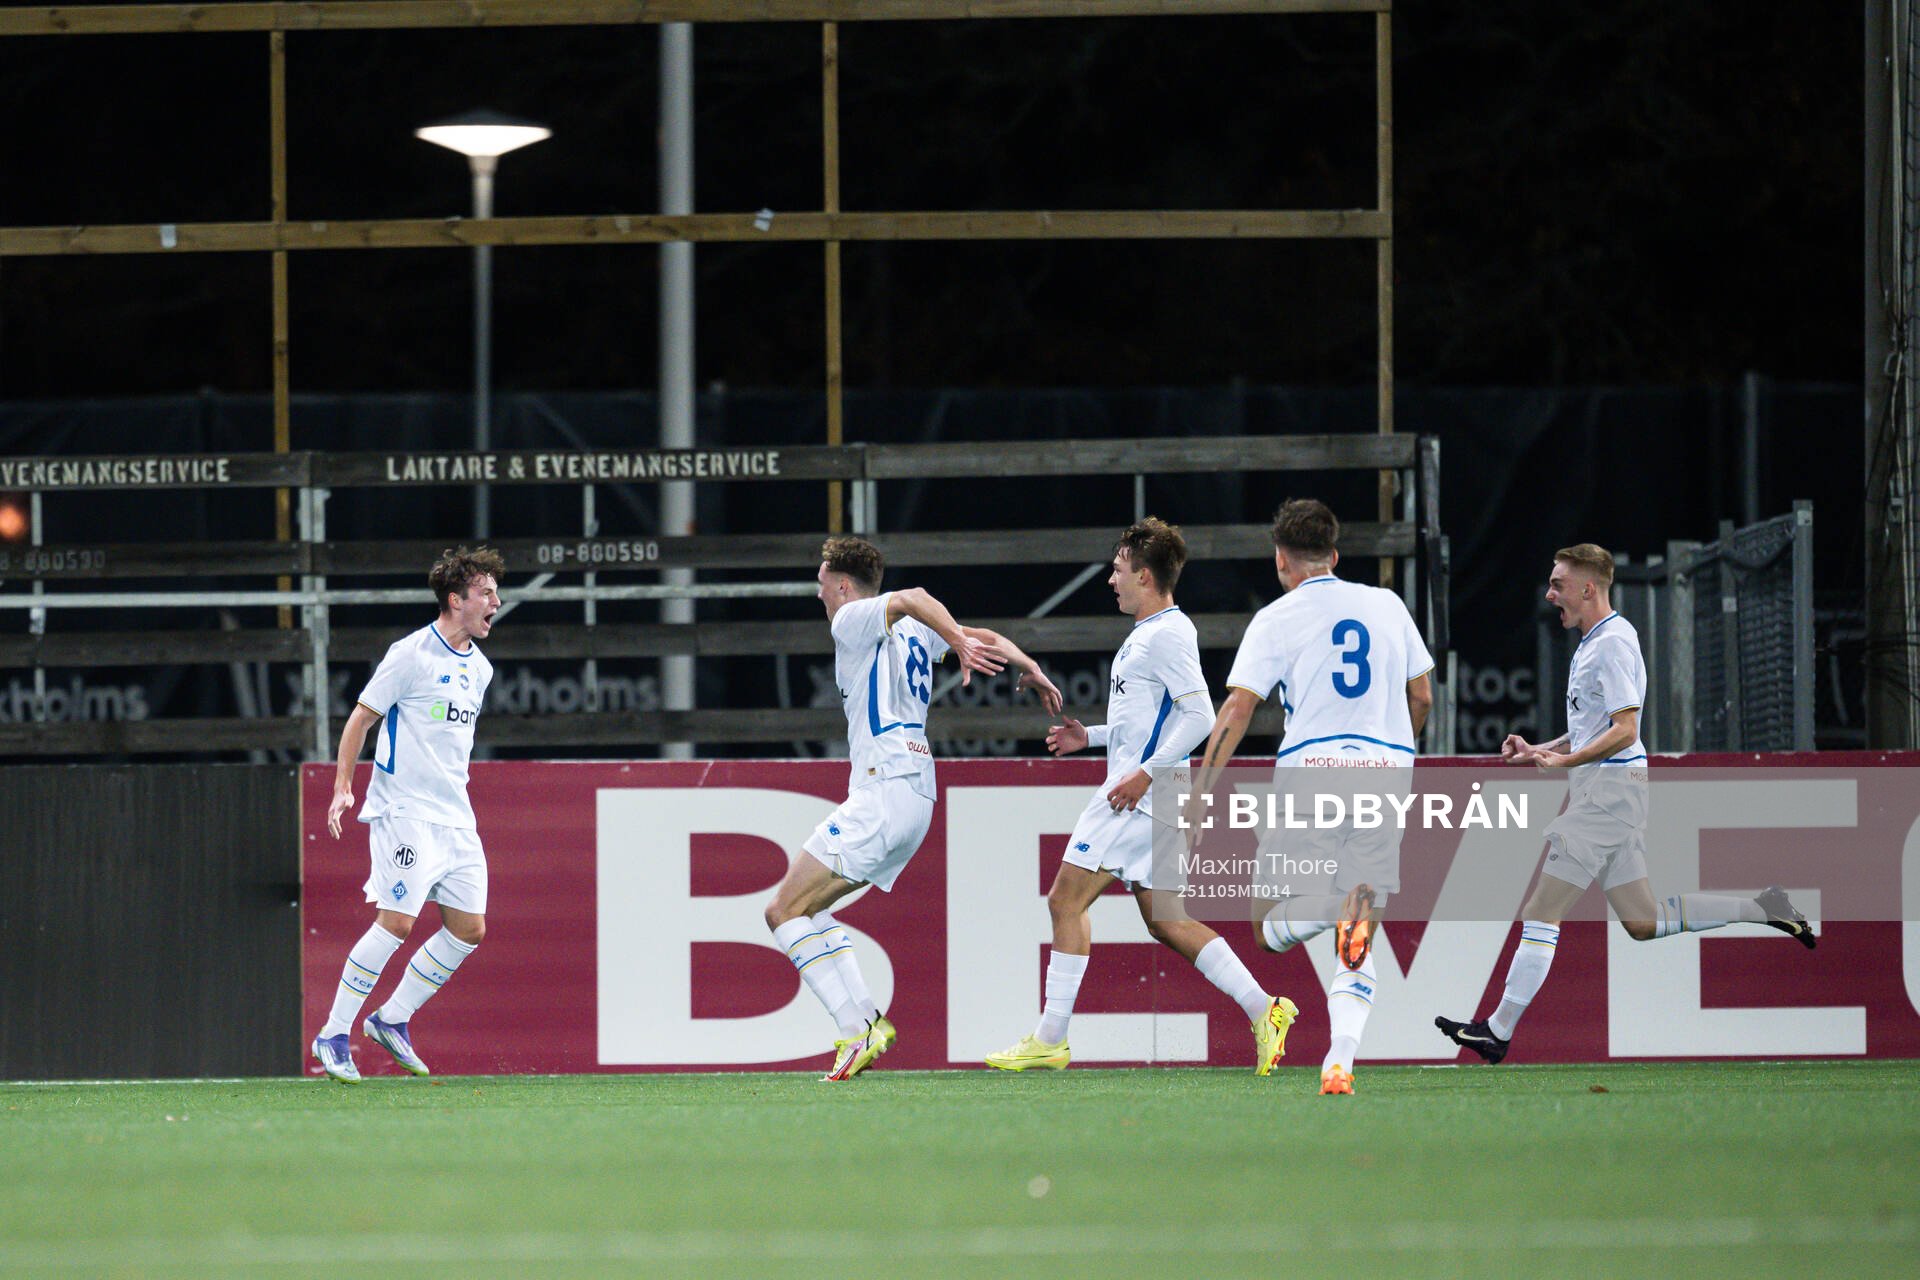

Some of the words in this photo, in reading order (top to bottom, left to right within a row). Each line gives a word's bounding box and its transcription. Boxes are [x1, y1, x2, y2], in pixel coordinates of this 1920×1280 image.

[508, 455, 525, 480] &
[536, 451, 781, 479] EVENEMANGSERVICE
[1332, 619, 1371, 699] 3
[395, 847, 415, 866] MG
[596, 778, 1920, 1066] BEVE
